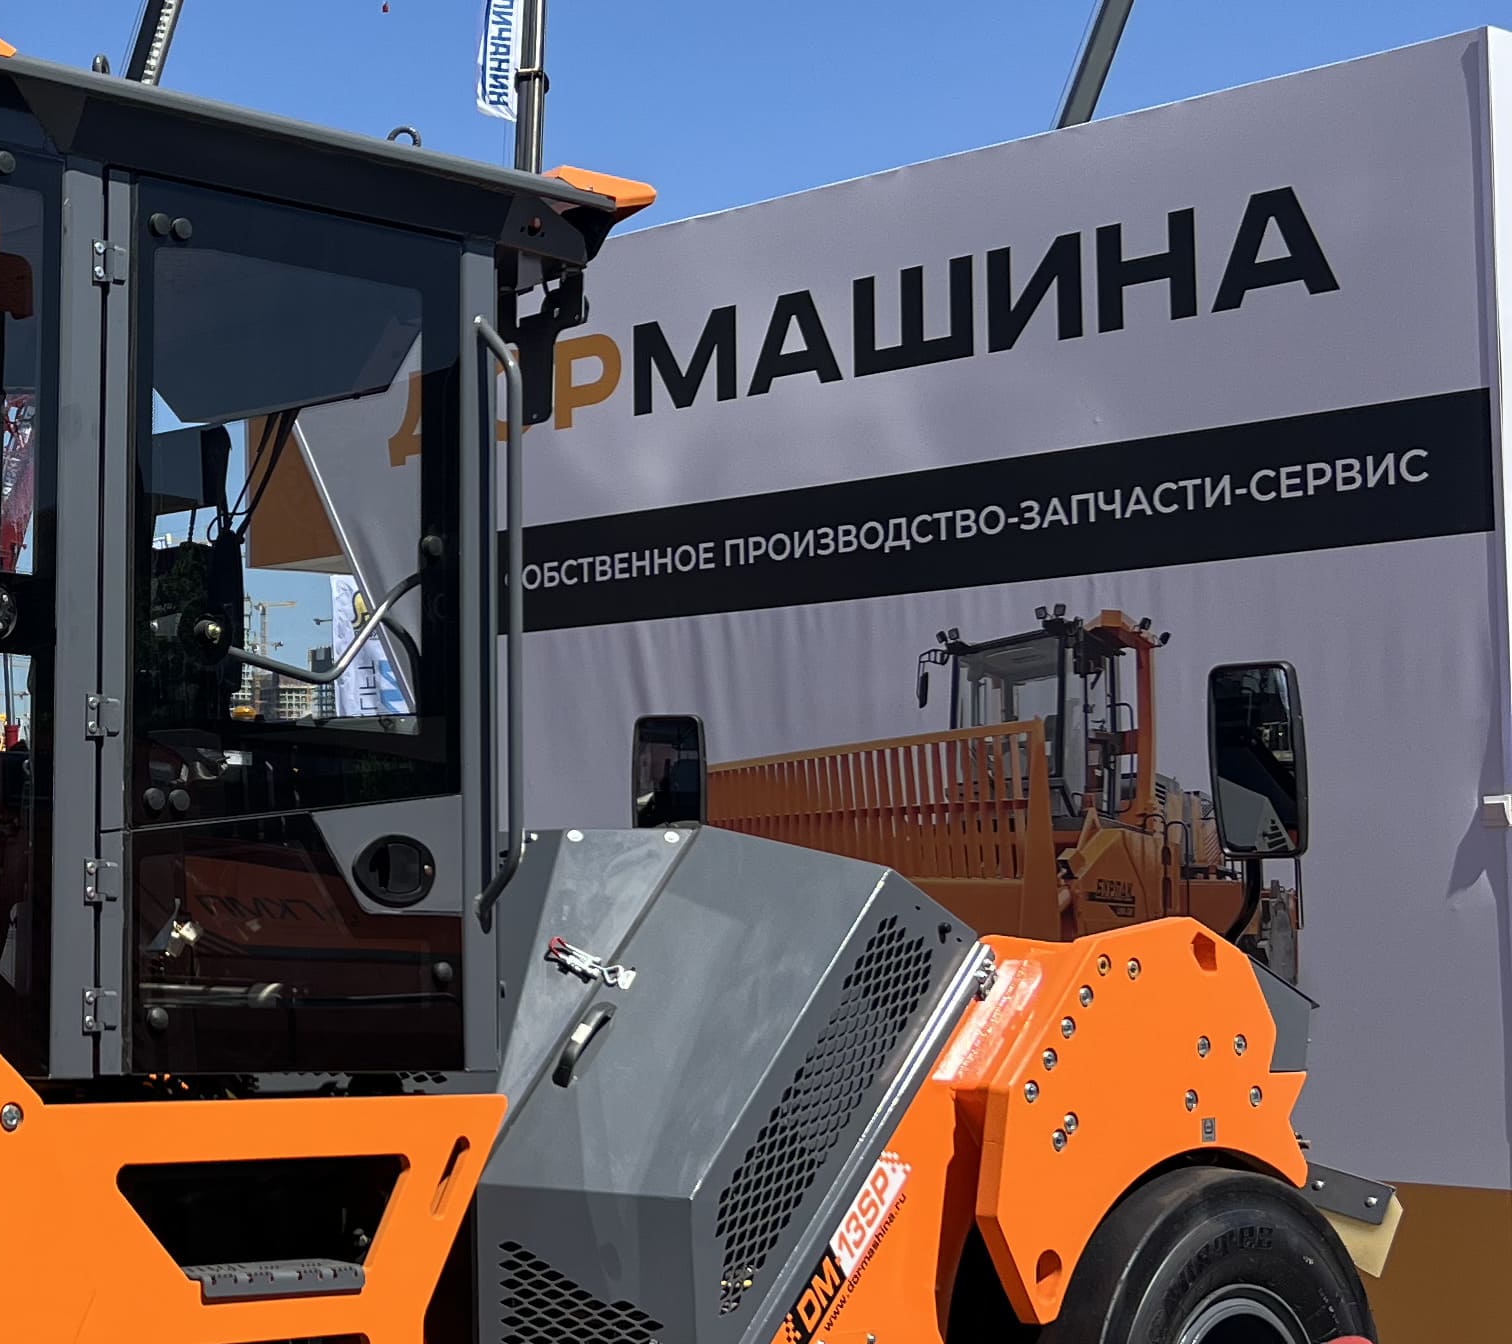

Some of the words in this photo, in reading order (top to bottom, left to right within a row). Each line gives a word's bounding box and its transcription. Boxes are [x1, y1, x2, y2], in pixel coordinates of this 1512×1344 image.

[388, 186, 1341, 468] РМАШИНА
[505, 542, 716, 591] ОБСТВЕННОЕ
[724, 448, 1430, 568] ПРОИЗВОДСТВО-ЗАПЧАСТИ-СЕРВИС
